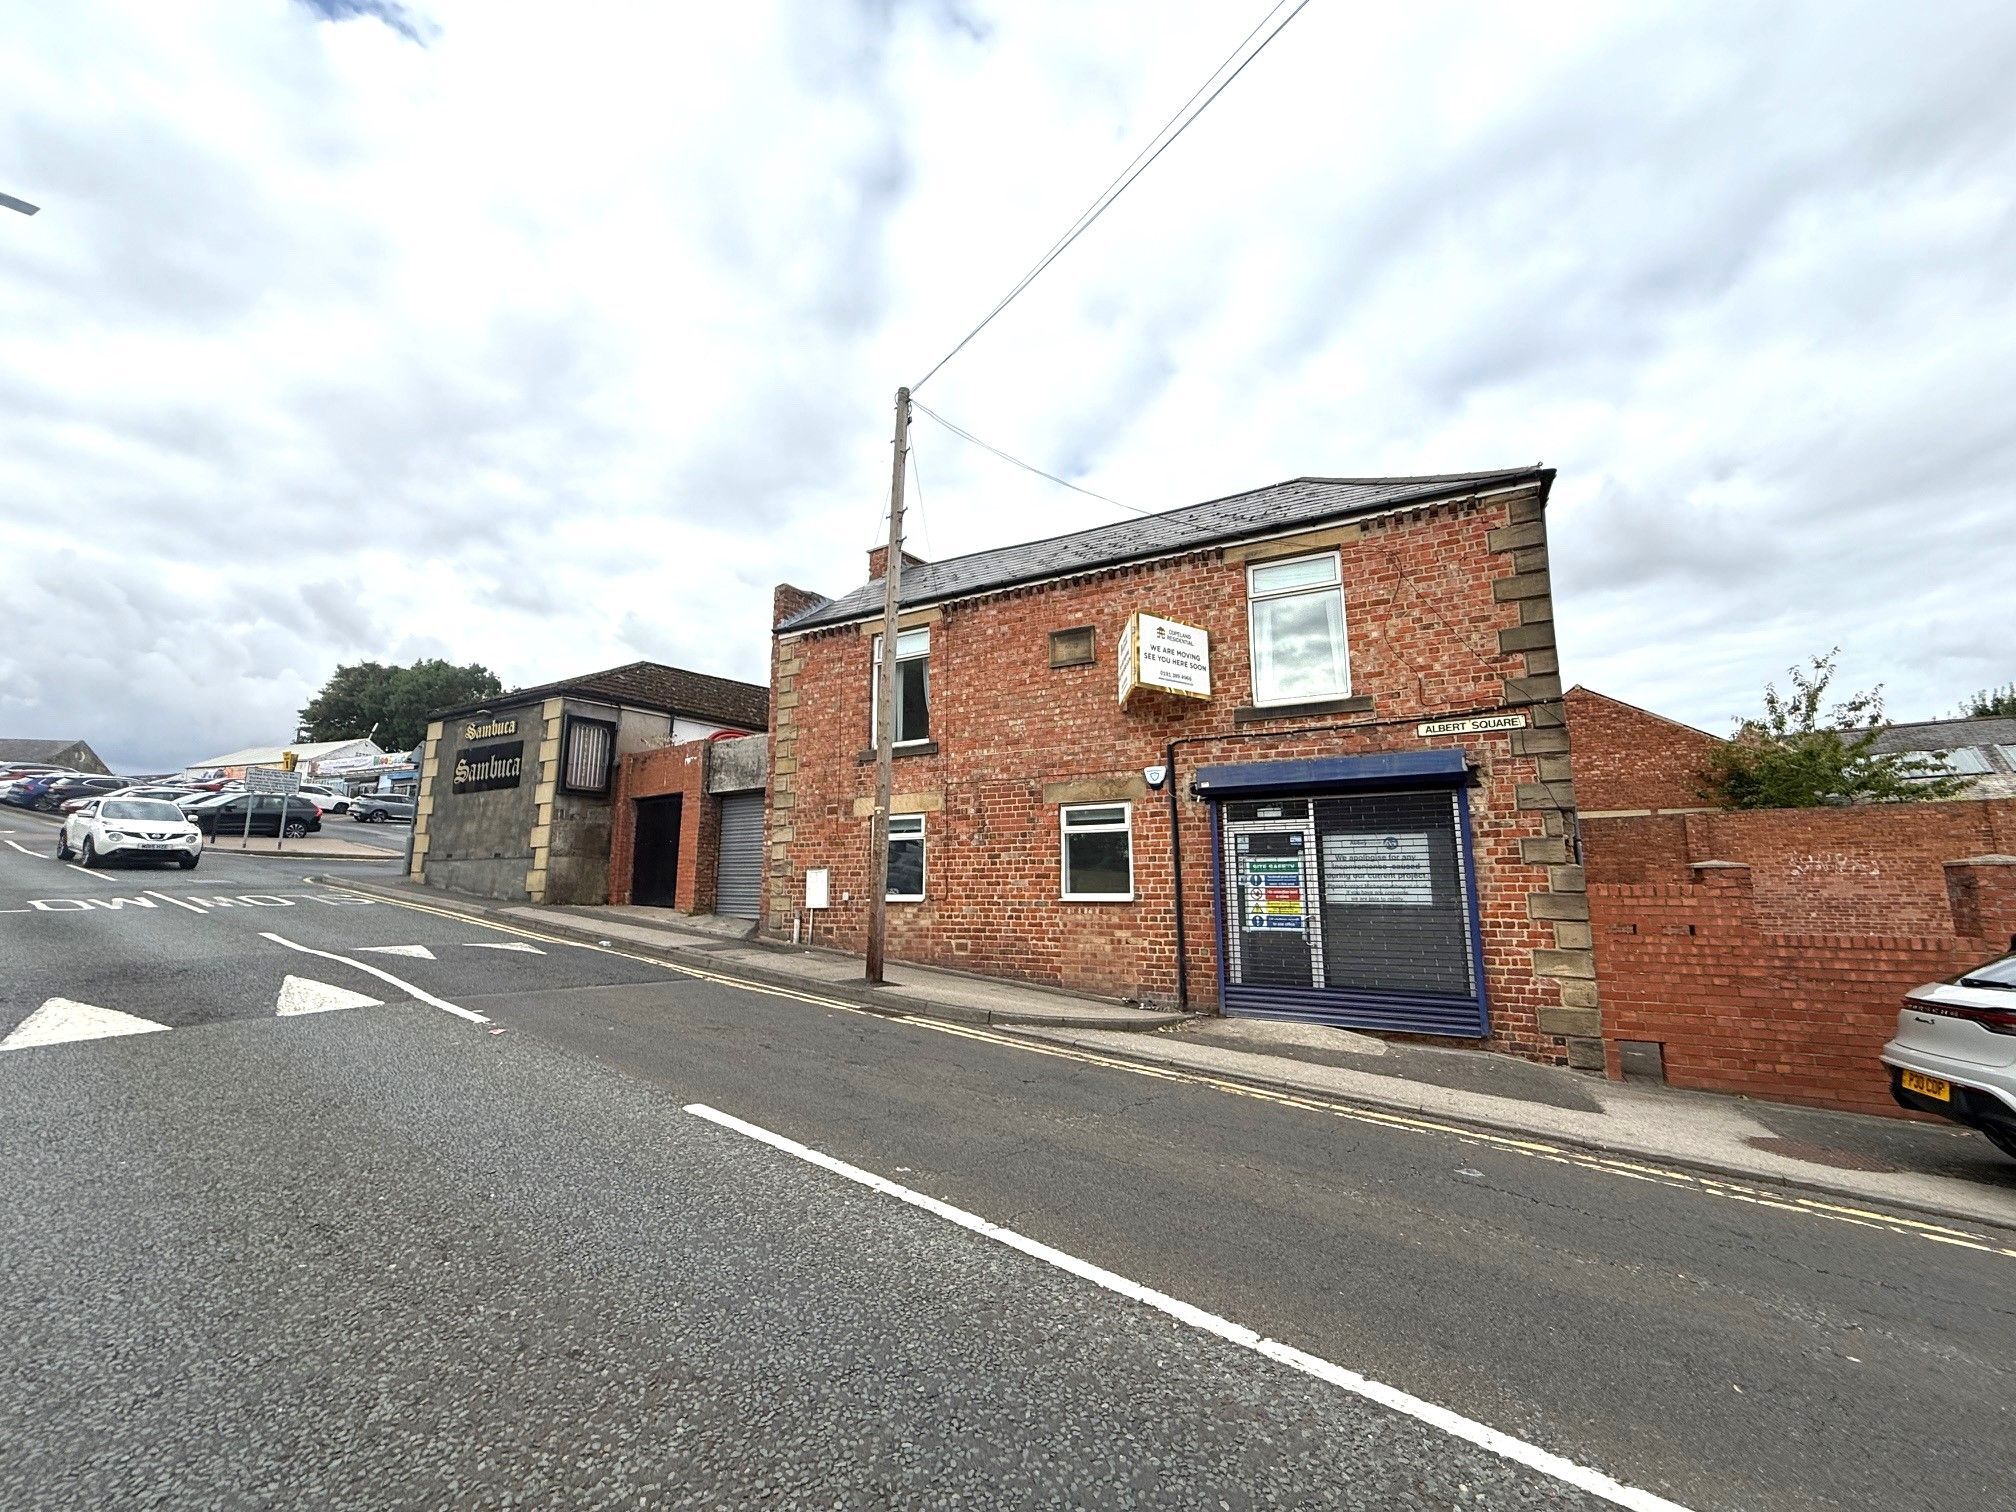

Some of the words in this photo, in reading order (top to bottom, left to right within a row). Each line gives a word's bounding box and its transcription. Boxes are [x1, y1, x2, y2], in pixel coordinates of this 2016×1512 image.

[1166, 636, 1194, 646] RESIDENTIAL
[1150, 644, 1161, 653] WE
[1162, 648, 1175, 656] ARE
[1176, 650, 1200, 661] MOVING
[1144, 652, 1156, 660] SEE
[1158, 656, 1170, 664] YOU
[1172, 660, 1188, 668] HERE
[1190, 662, 1206, 671] SOON
[465, 720, 515, 740] Sambuca
[1425, 722, 1466, 733] ALBERT
[1472, 717, 1519, 730] SQUARE
[454, 754, 520, 784] Sambuca
[1349, 854, 1386, 862] apologise
